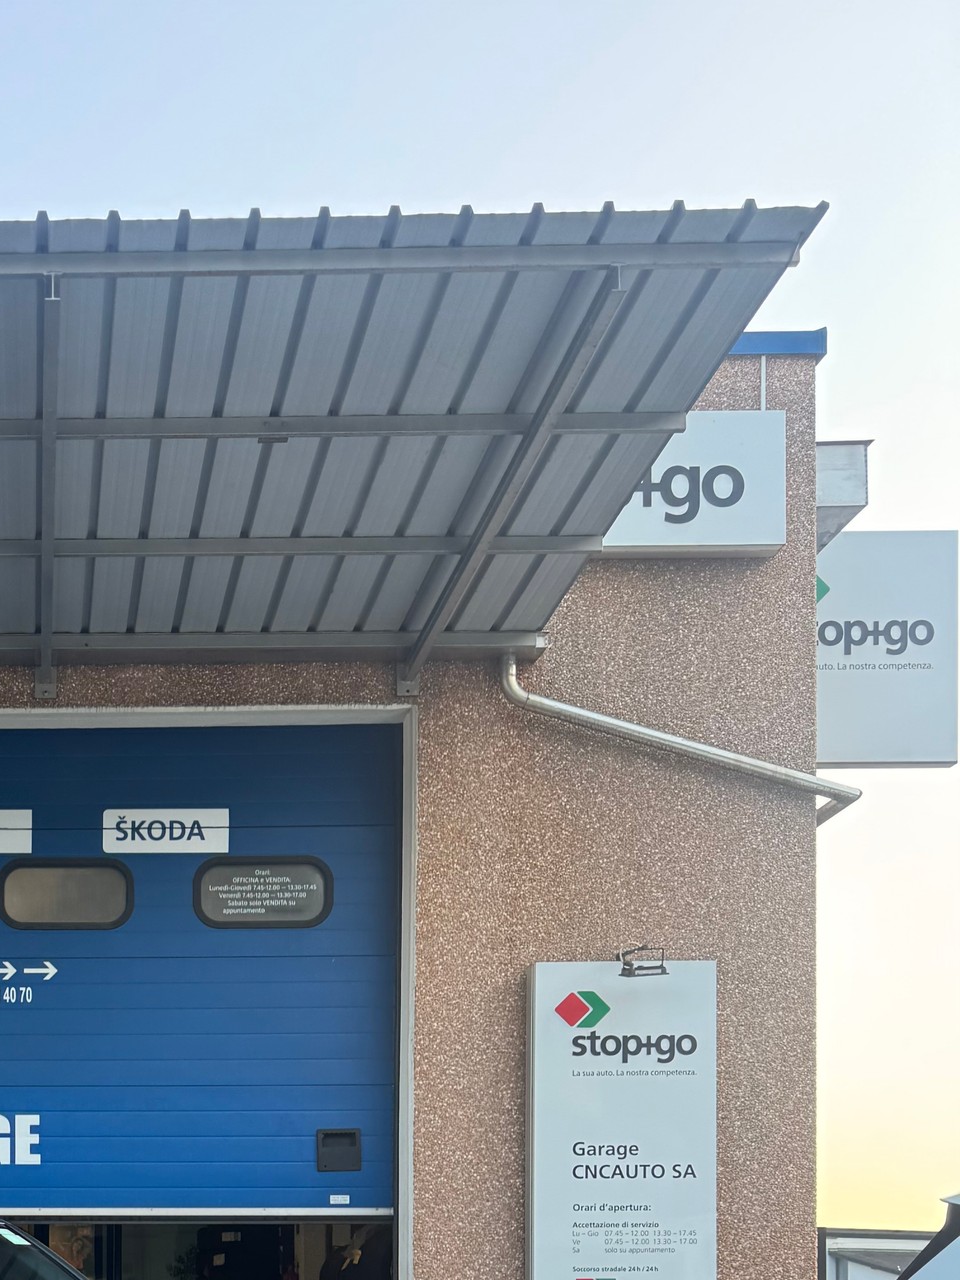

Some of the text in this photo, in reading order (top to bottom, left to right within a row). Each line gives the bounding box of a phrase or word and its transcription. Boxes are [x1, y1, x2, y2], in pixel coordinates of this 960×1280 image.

[816, 619, 935, 656] op+go
[816, 662, 934, 672] uto. La nostra competenza.
[115, 816, 206, 841] ŠKODA
[3, 987, 16, 1003] 40
[19, 987, 32, 1003] 70
[571, 1031, 697, 1064] stop+go
[650, 1069, 698, 1078] competenza.
[572, 1141, 639, 1160] Garage
[572, 1163, 697, 1179] CNCAUTO SA
[572, 1203, 596, 1212] Orari
[628, 1247, 676, 1255] appuntamento
